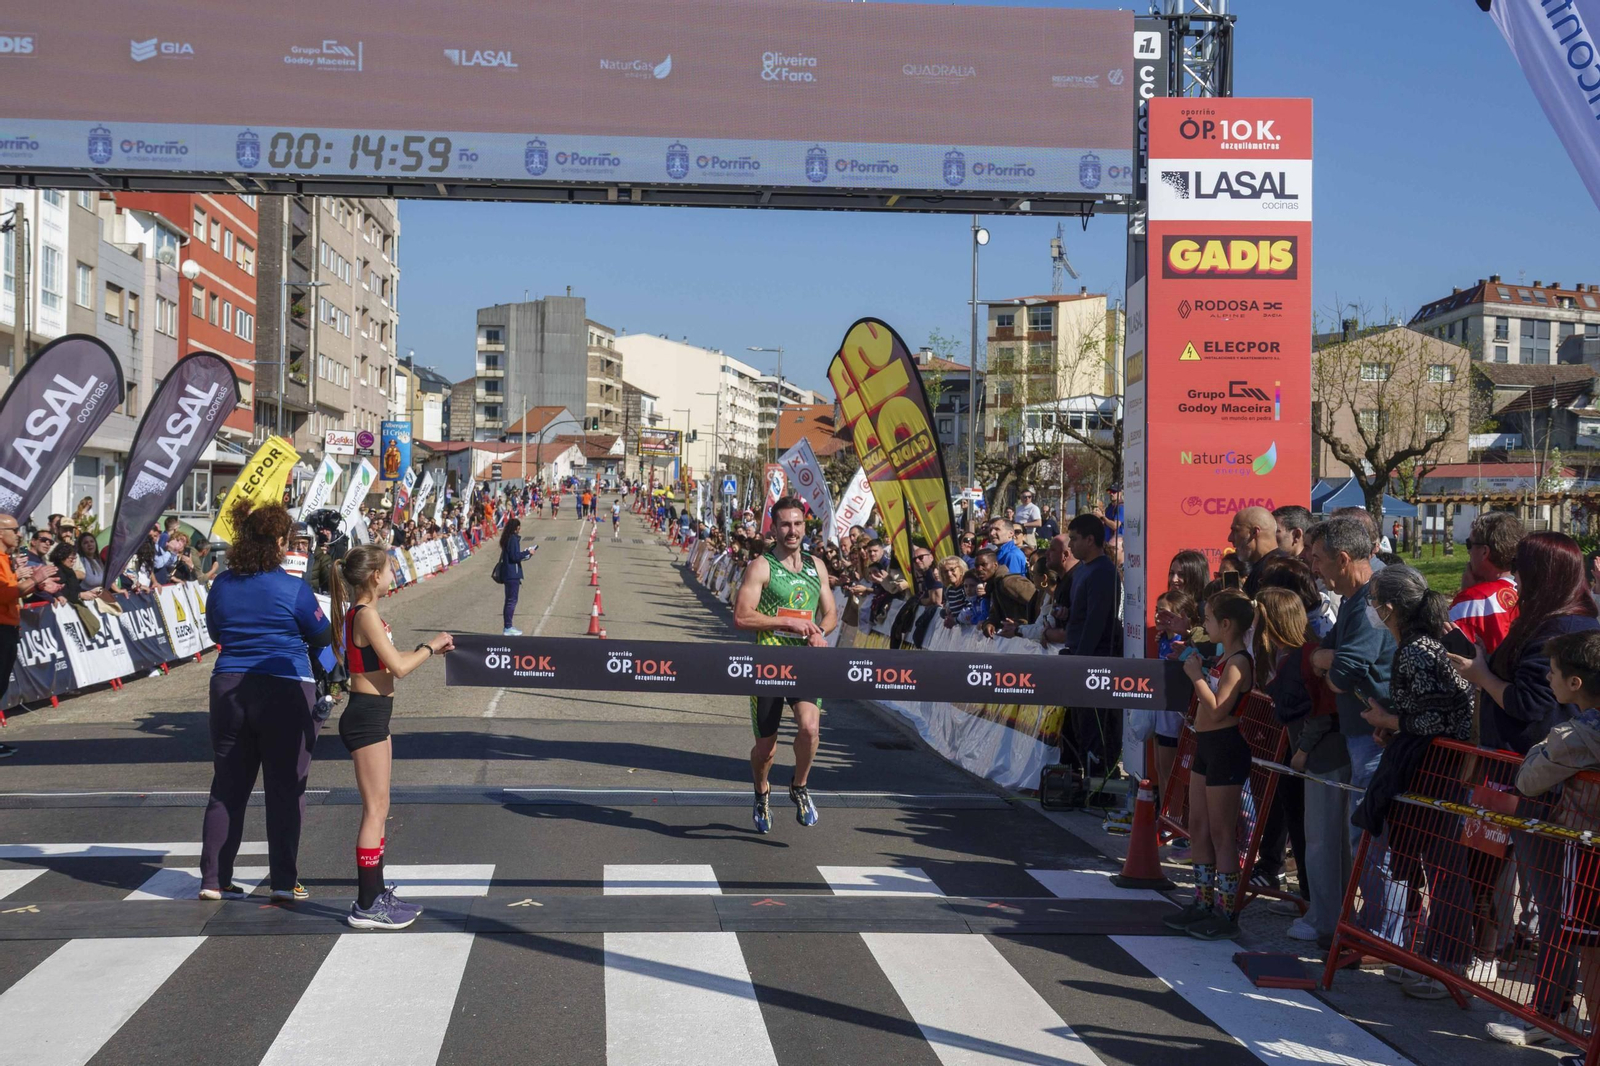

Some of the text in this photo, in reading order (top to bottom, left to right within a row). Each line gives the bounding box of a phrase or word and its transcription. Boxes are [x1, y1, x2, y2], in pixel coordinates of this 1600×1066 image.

[160, 42, 195, 54] GIA
[290, 45, 321, 55] Grupo
[284, 56, 356, 66] Godoy Maceira
[461, 50, 518, 67] LASAL
[600, 59, 654, 71] NaturGas
[762, 52, 817, 66] Oliveira
[1181, 108, 1216, 118] oporriño
[120, 139, 189, 155] O Porriño
[555, 151, 621, 167] O Porriño
[696, 155, 761, 171] O Porriño
[835, 159, 899, 174] O Porriño
[972, 162, 1036, 177] O Porriño
[1195, 171, 1299, 200] LASAL
[1262, 201, 1299, 210] cocinas
[1168, 240, 1294, 274] GADIS
[1194, 300, 1260, 311] RODOSA
[1203, 341, 1280, 353] ELECPOR
[1187, 389, 1225, 400] Grupo
[76, 381, 109, 424] cocinas
[206, 385, 228, 421] cocinas
[1178, 403, 1272, 415] Godoy Maceira
[0, 374, 98, 491] LASAL
[144, 381, 219, 478] LASAL
[1181, 451, 1253, 465] NaturGas
[231, 447, 283, 505] LECPOR
[1215, 467, 1251, 476] energy
[75, 612, 121, 651] LSAL
[129, 607, 163, 641] LASAL
[20, 628, 65, 667] LASAL
